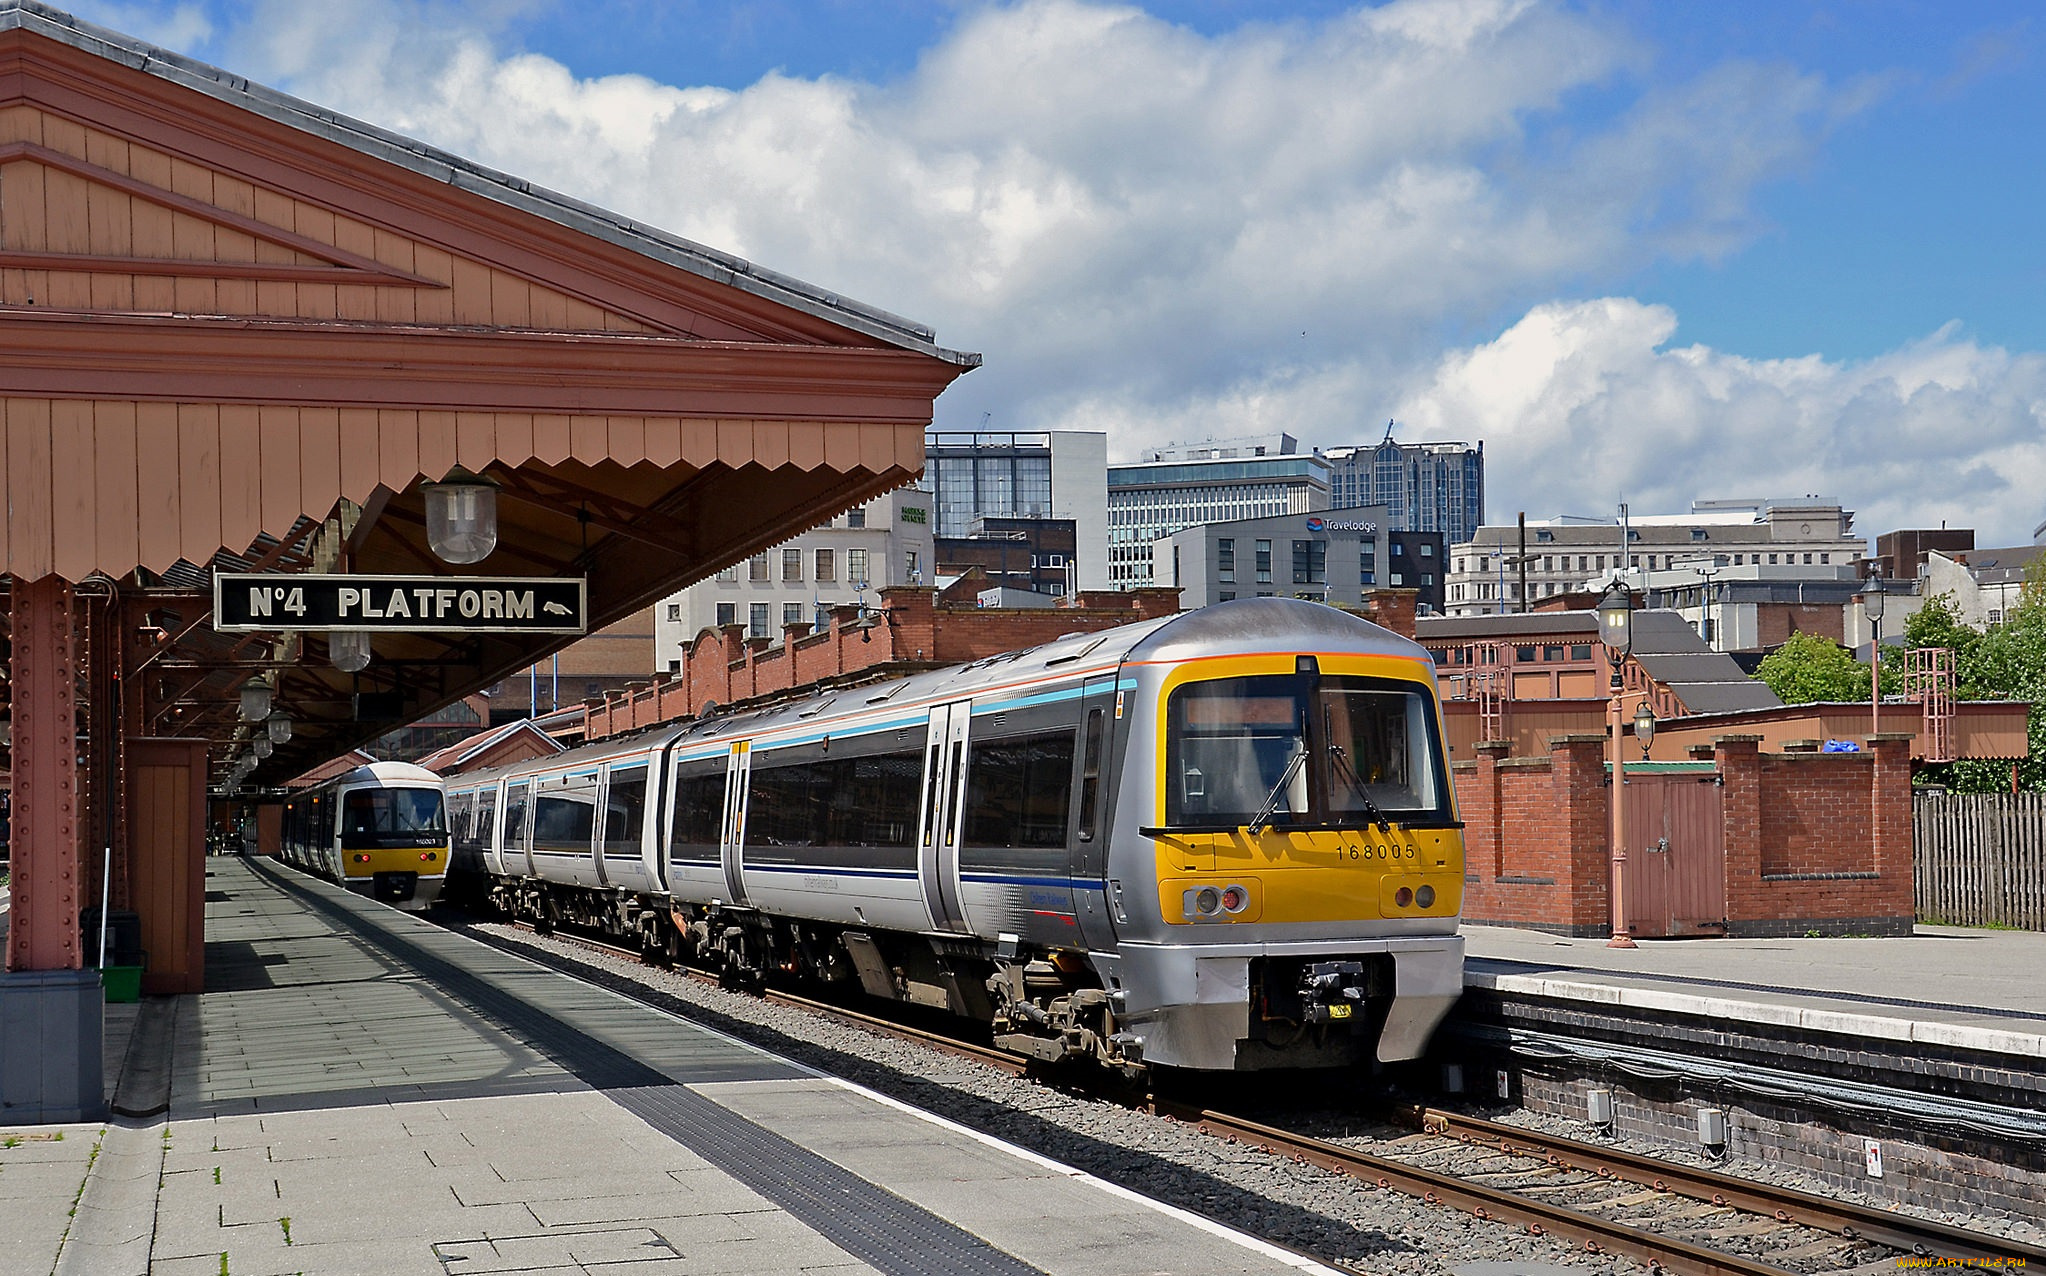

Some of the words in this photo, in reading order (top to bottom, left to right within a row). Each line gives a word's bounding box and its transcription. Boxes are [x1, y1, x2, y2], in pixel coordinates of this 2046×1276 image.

[1324, 518, 1376, 533] Travelodge
[338, 588, 535, 619] PLATFORM
[1336, 844, 1415, 861] 168005
